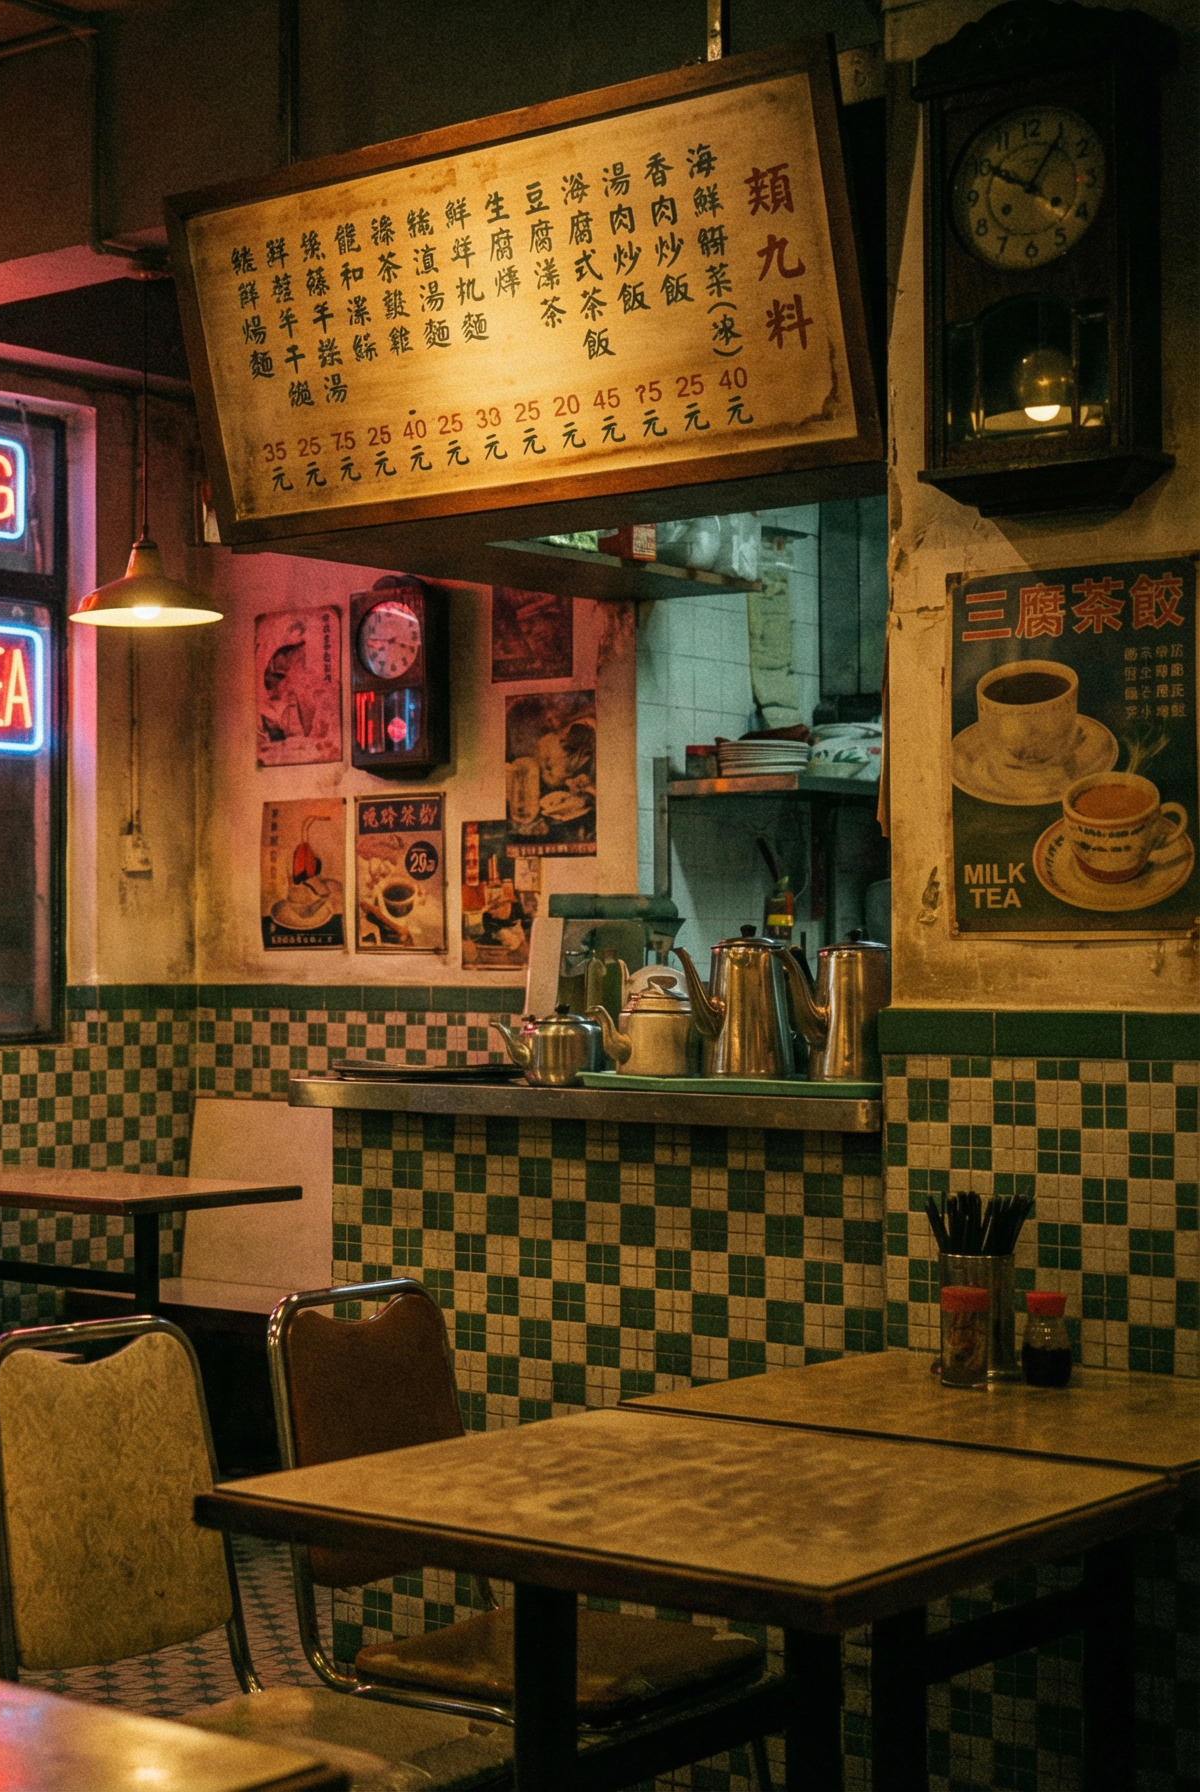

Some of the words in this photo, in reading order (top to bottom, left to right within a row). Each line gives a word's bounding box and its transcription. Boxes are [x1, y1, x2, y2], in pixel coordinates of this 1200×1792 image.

[1021, 118, 1041, 139] 12
[997, 131, 1009, 152] 11
[1076, 137, 1090, 158] 2
[967, 190, 979, 207] 9
[644, 152, 694, 307] 香肉炒飯
[975, 218, 988, 236] 8
[1054, 228, 1066, 246] 5
[997, 236, 1008, 254] 7
[1025, 241, 1038, 258] 6
[602, 161, 651, 314] 湯肉炒飯
[643, 409, 667, 436] 元
[675, 374, 704, 398] 25
[719, 367, 747, 390] 40
[553, 394, 580, 416] 20
[593, 388, 621, 410] 45
[514, 401, 540, 422] 25
[685, 402, 710, 431] 元
[727, 396, 753, 425] 元
[403, 419, 427, 440] 40
[438, 413, 463, 435] 25
[562, 422, 586, 448] 元
[601, 415, 626, 443] 元
[367, 425, 392, 446] 25
[523, 428, 546, 455] 元
[263, 442, 287, 463] 35
[297, 437, 321, 457] 25
[447, 440, 470, 466] 元
[485, 434, 508, 460] 元
[340, 456, 361, 481] 元
[374, 451, 397, 477] 元
[410, 445, 432, 472] 元
[272, 466, 293, 491] 元
[306, 462, 326, 487] 元
[962, 572, 1185, 642] 三腐茶餃
[963, 863, 1026, 885] MILK
[969, 888, 1023, 909] TEA
